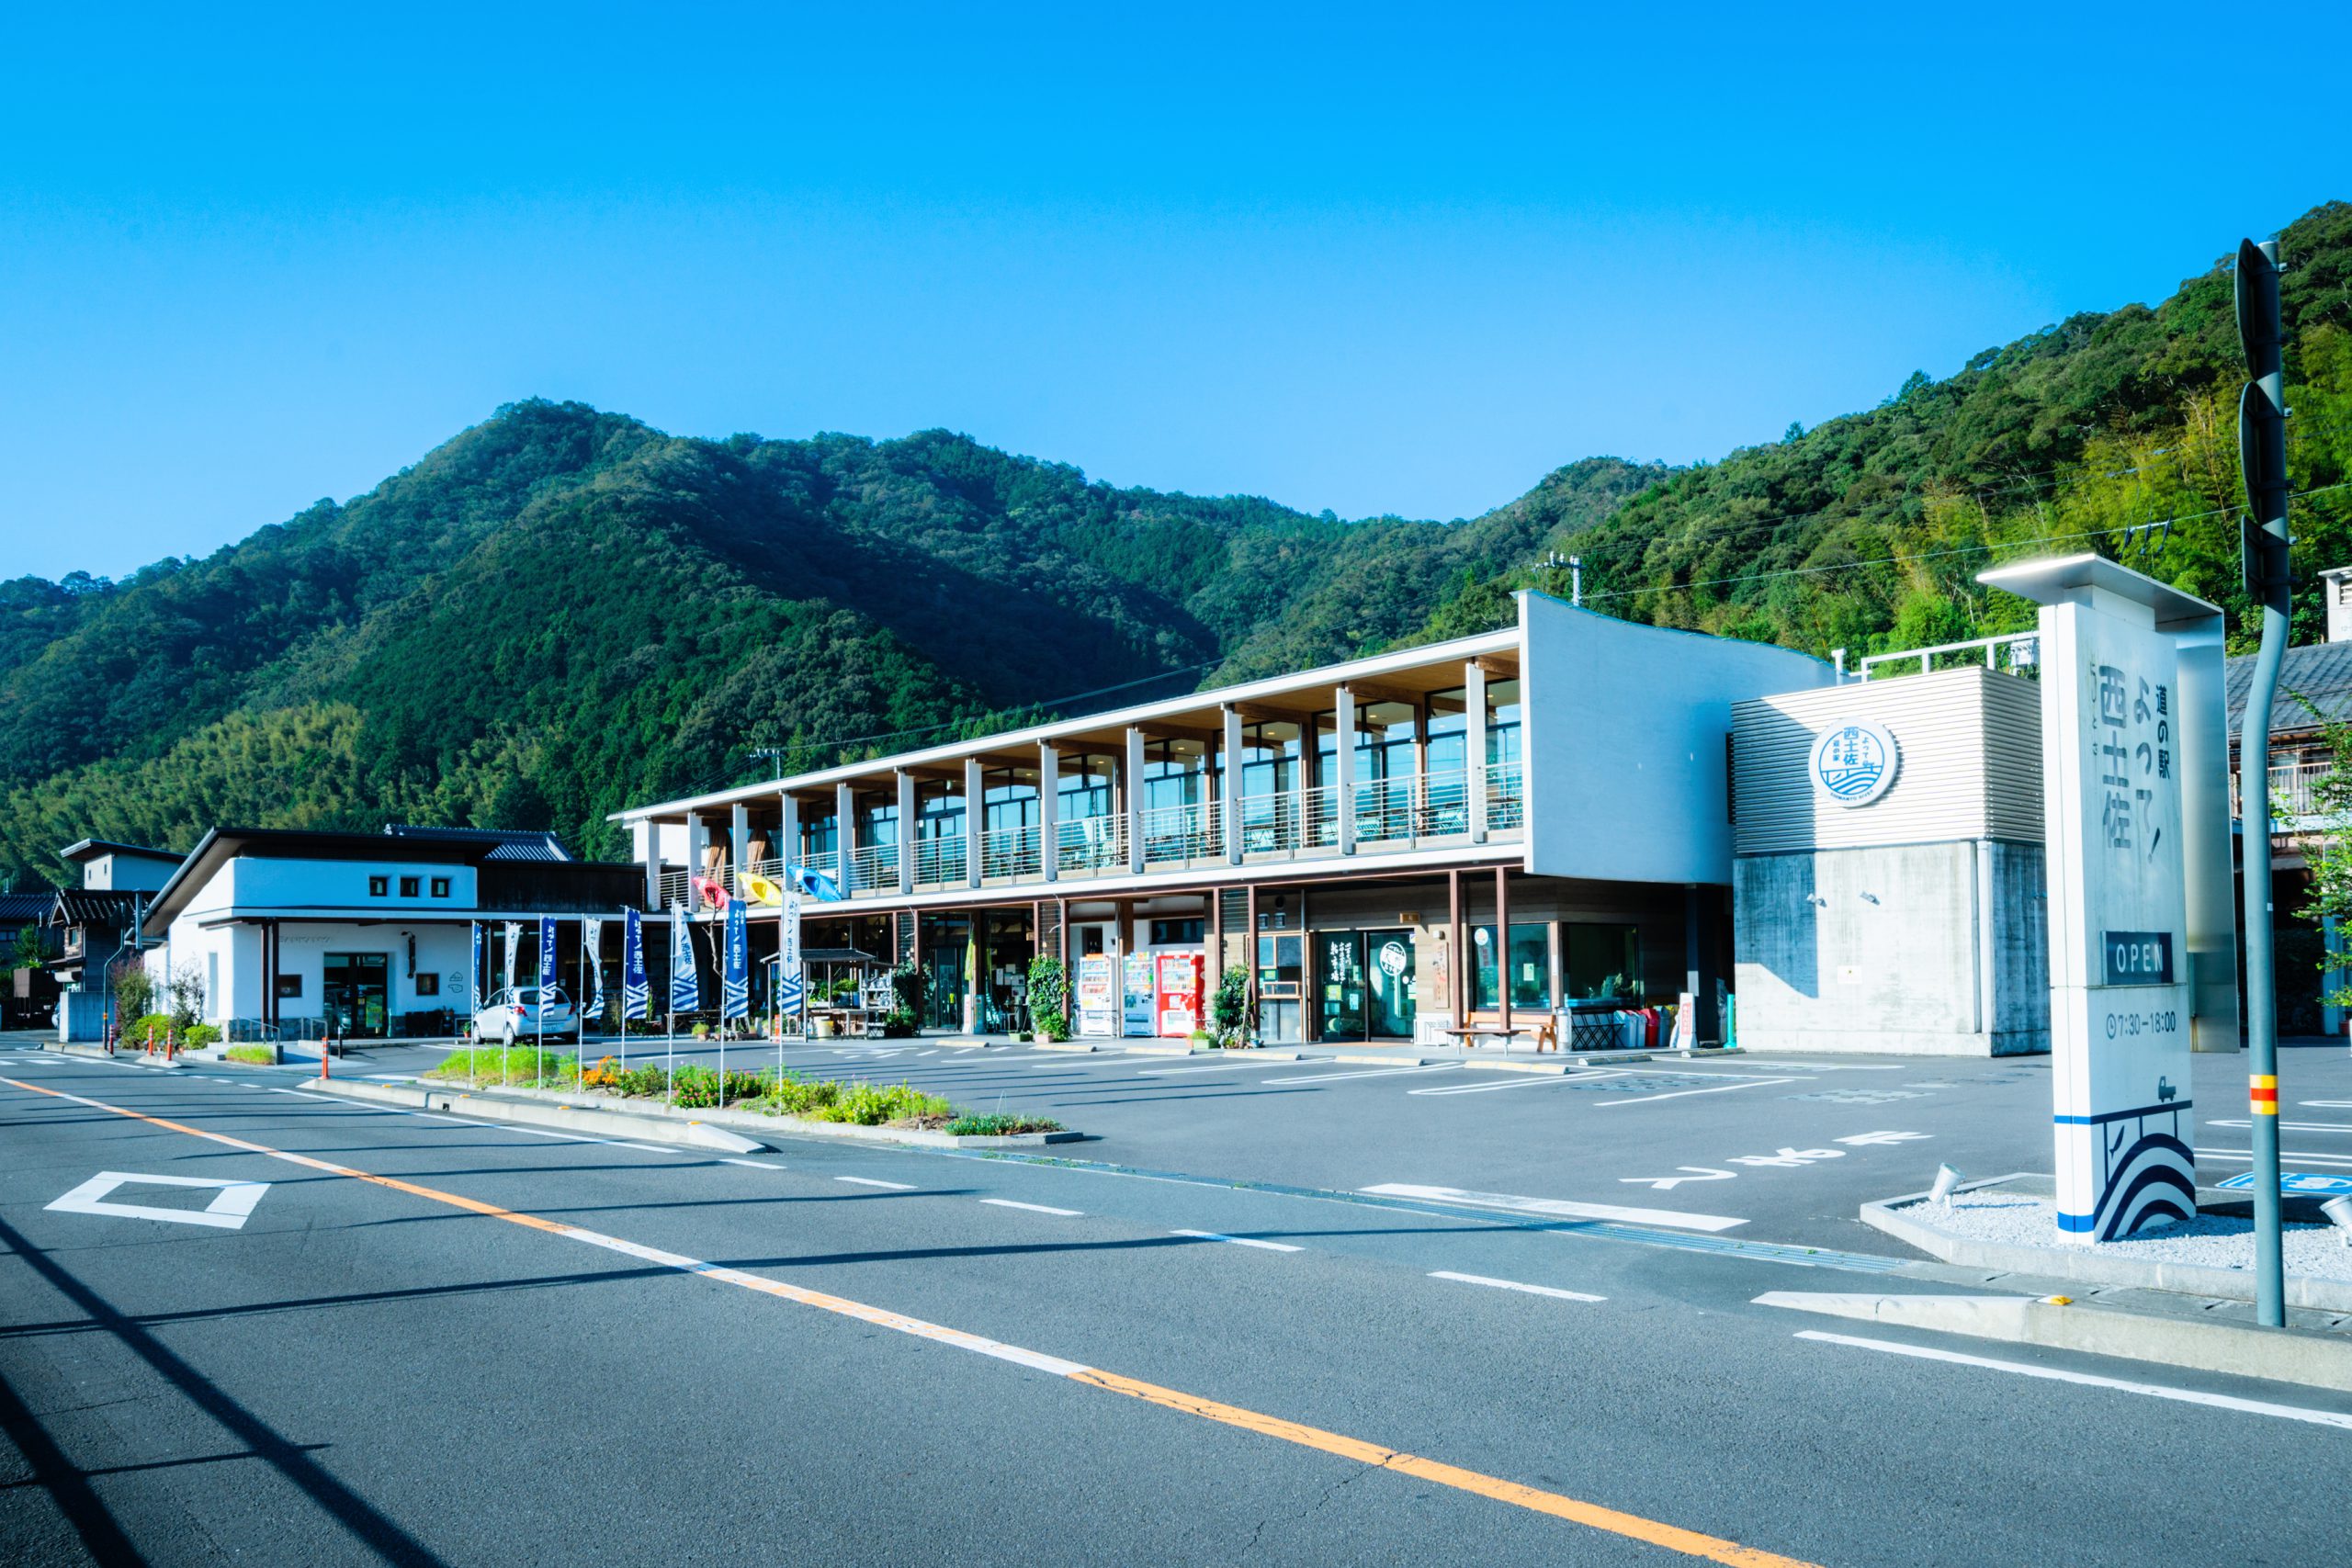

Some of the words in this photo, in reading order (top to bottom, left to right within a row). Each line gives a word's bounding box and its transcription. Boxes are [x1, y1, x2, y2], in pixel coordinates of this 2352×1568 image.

[1843, 727, 1859, 765] 西土佐
[2098, 665, 2132, 849] 西土佐
[2155, 684, 2170, 780] 道の駅
[2116, 943, 2164, 973] OPEN
